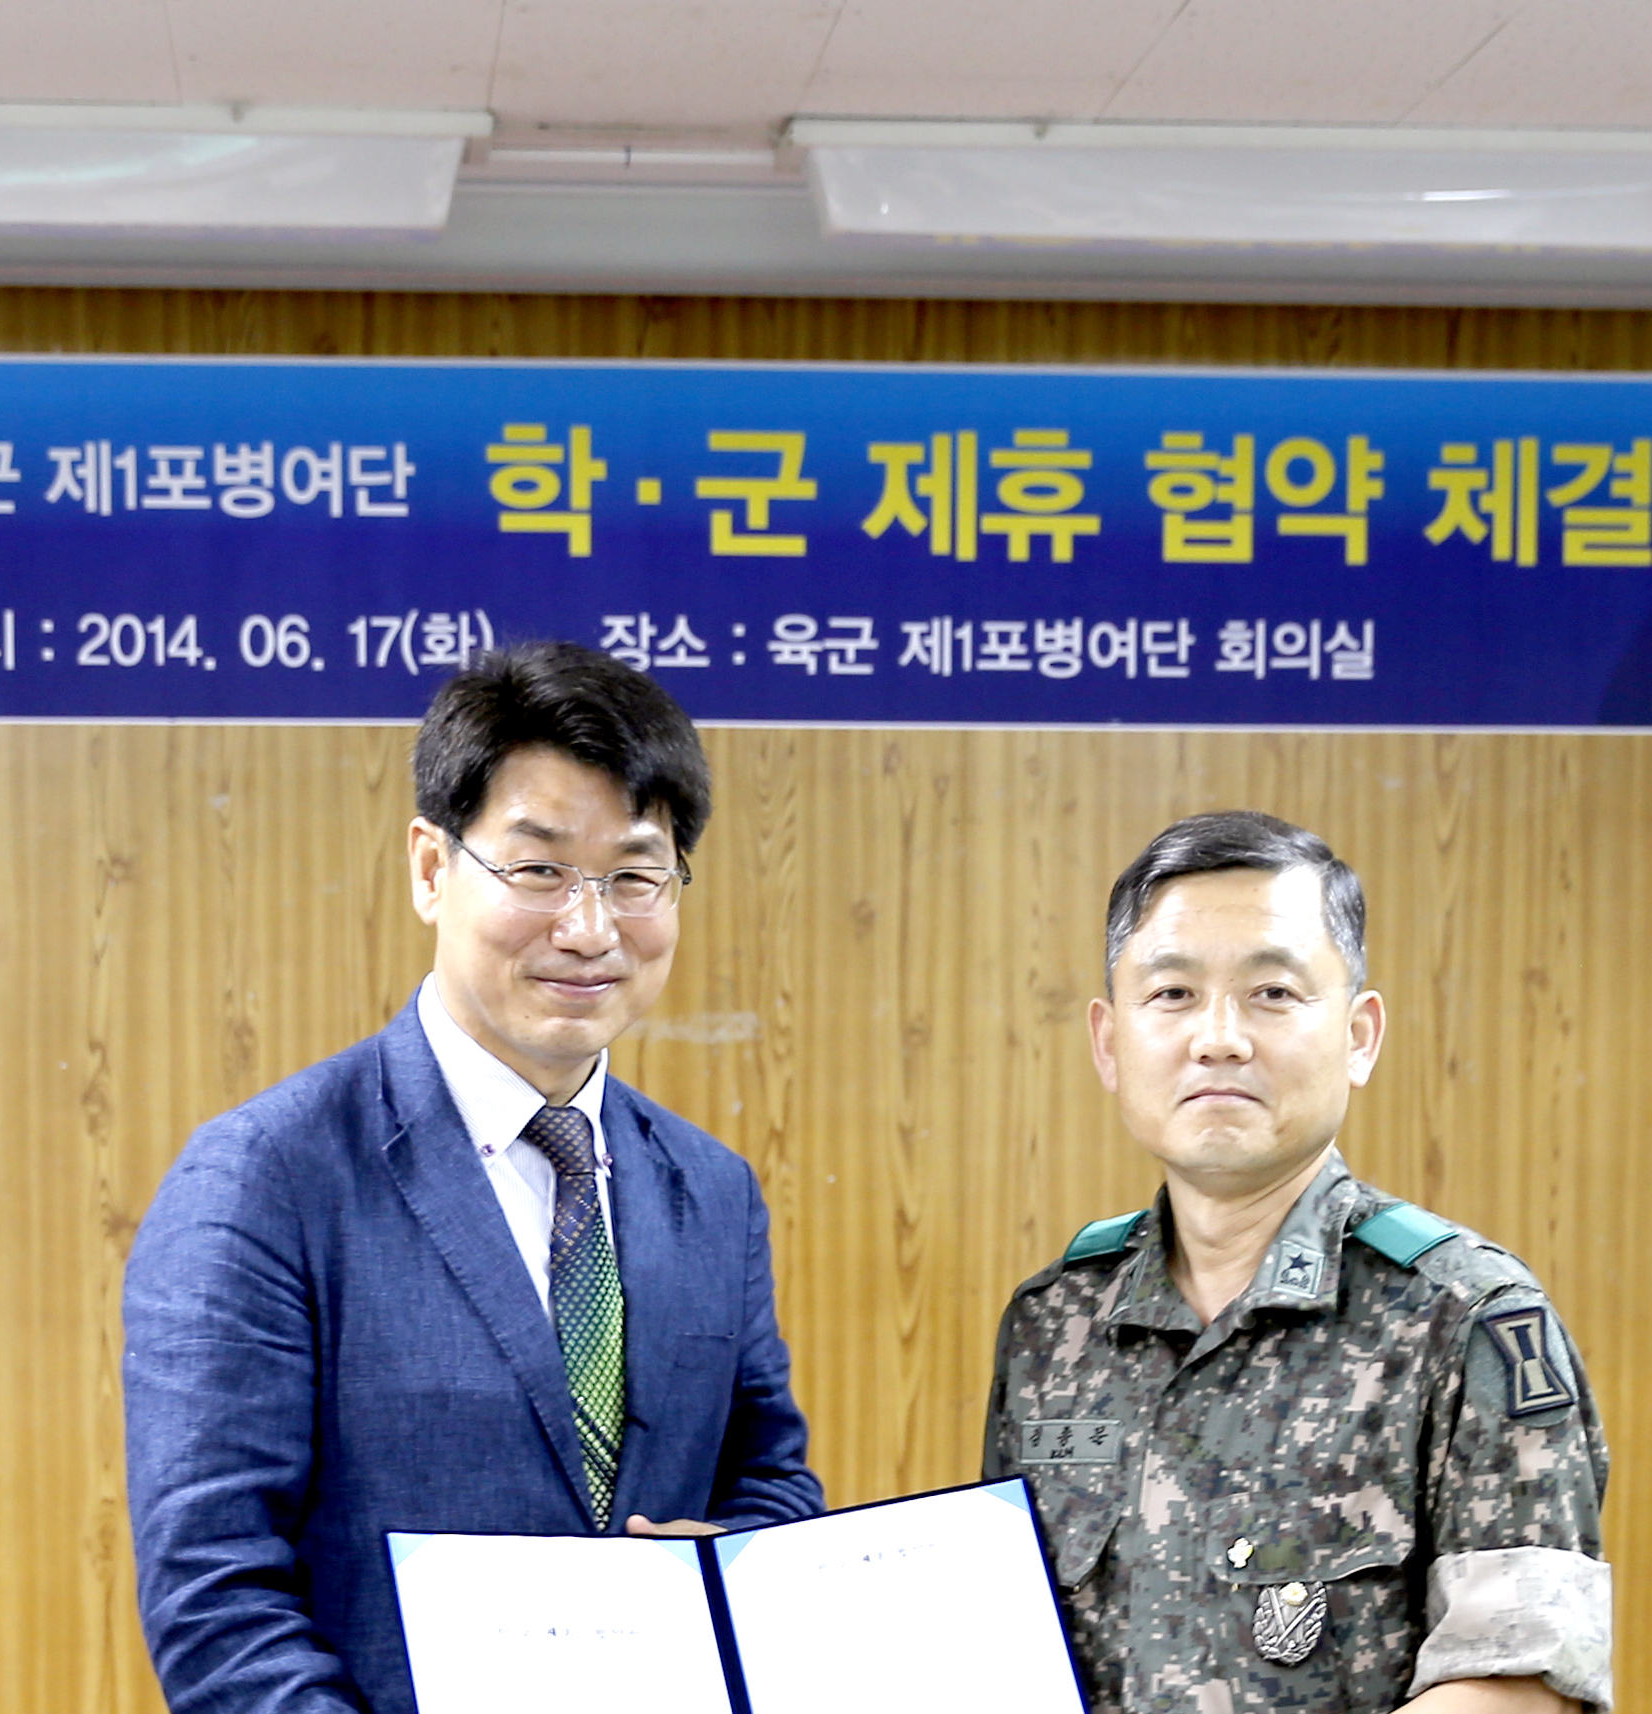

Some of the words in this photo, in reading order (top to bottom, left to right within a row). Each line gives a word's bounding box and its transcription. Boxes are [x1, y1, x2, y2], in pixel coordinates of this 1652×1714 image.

[45, 439, 417, 519] 제1포병여단
[862, 429, 1101, 564] 제휴
[1145, 432, 1385, 567] 협약
[76, 612, 218, 672] 2014.
[238, 613, 326, 672] 06.
[347, 608, 495, 677] 17(화)
[599, 612, 712, 674] 장소
[767, 613, 880, 677] 육군
[898, 616, 1196, 680] 제1포병여단
[1214, 619, 1376, 681] 회의실
